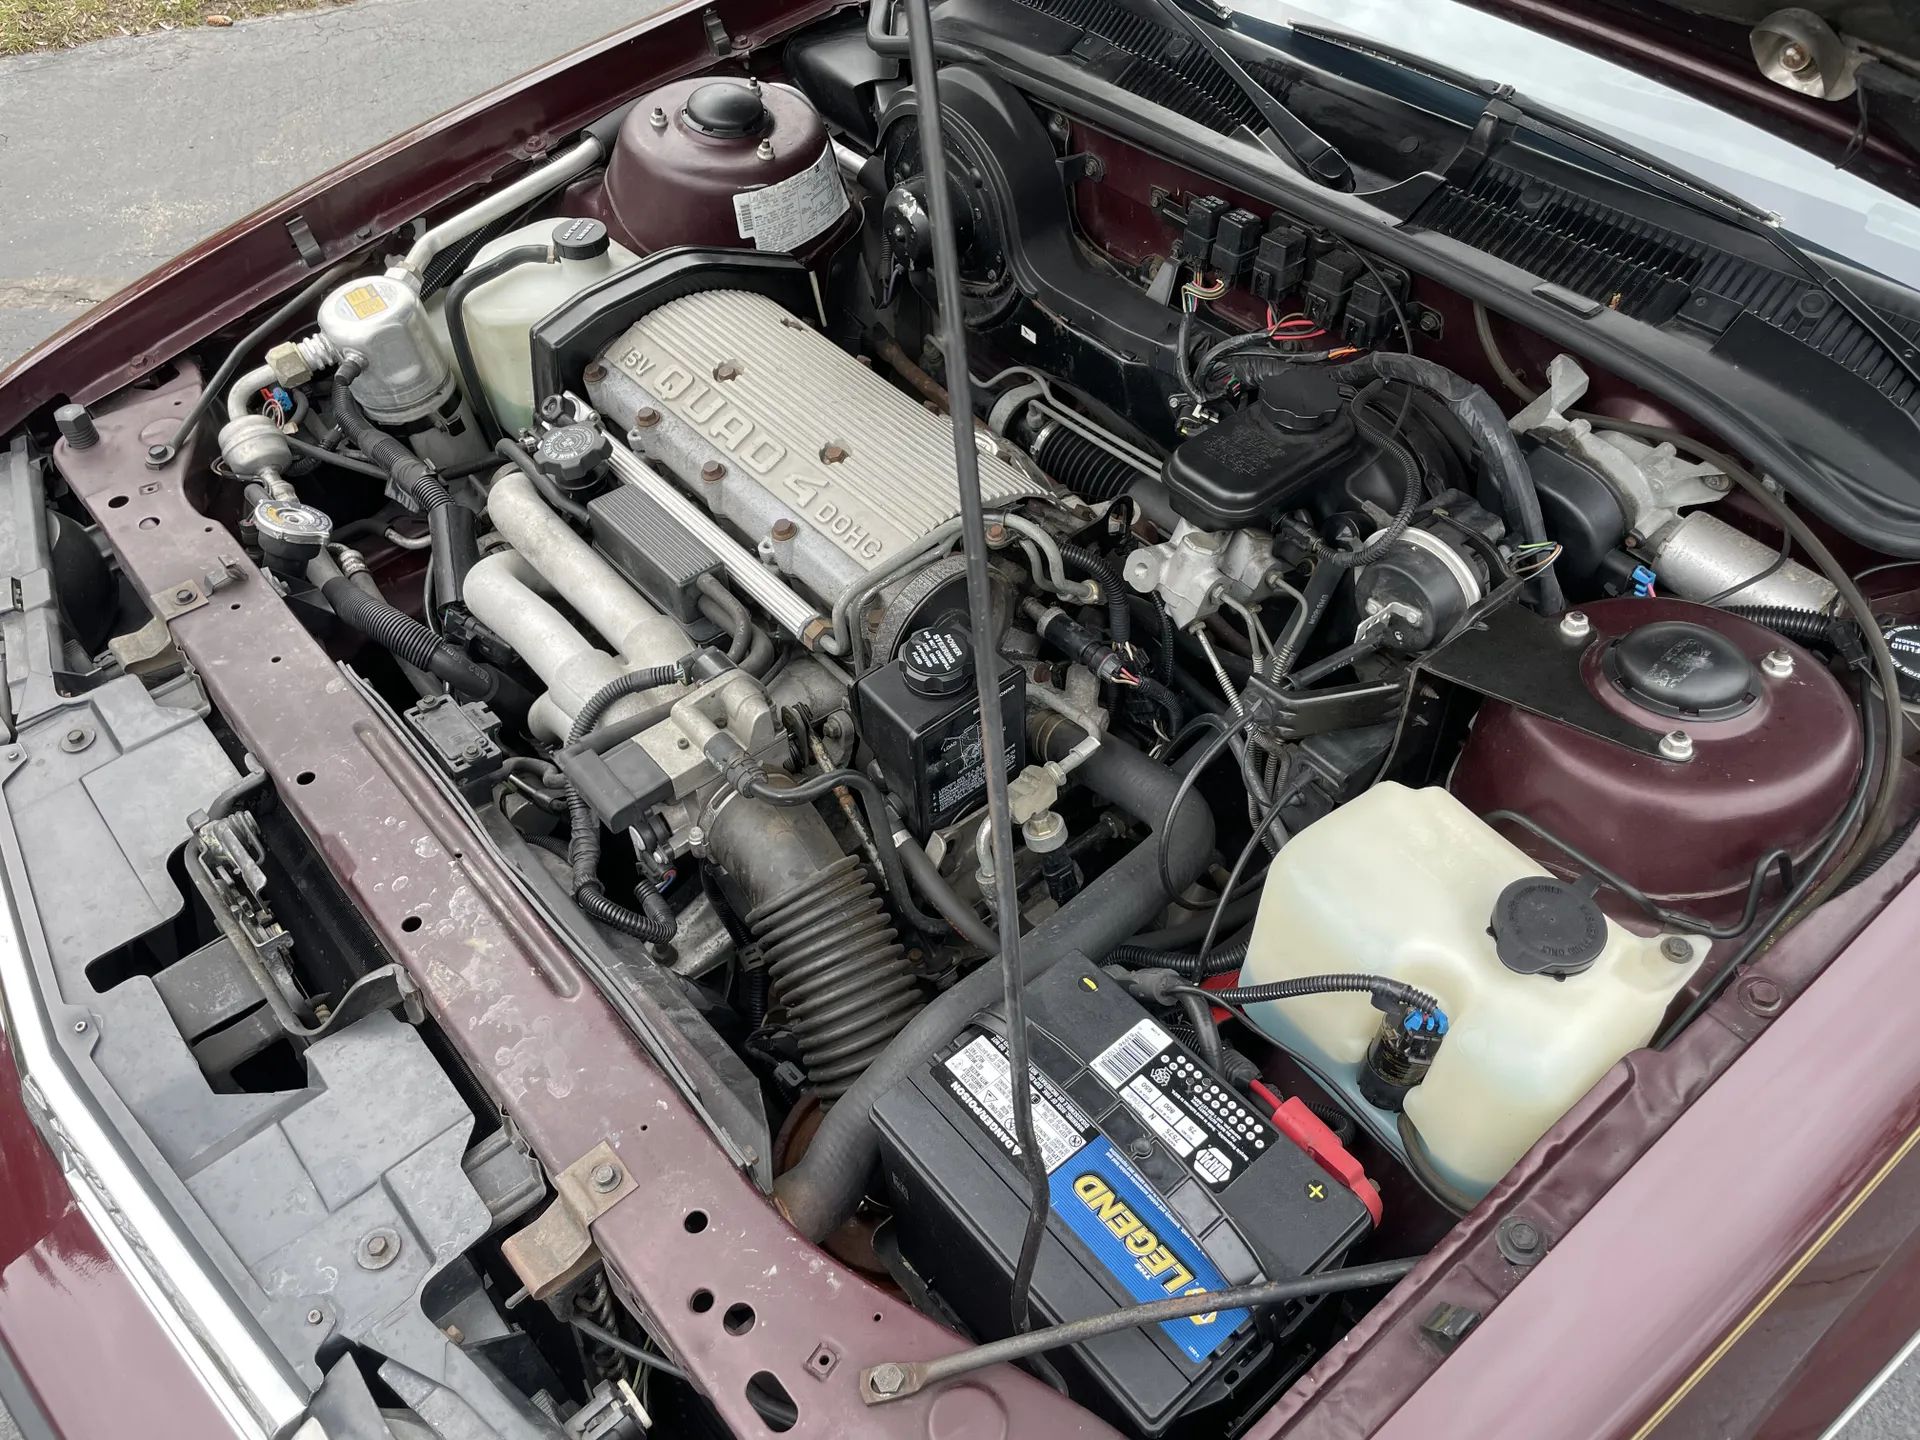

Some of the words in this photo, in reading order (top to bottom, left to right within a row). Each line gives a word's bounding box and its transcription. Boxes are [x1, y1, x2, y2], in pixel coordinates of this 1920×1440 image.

[653, 364, 787, 474] QUAD
[783, 471, 830, 508] 4
[814, 503, 883, 560] DOHC
[932, 632, 956, 664] STEERING
[942, 632, 963, 657] POWER
[1891, 642, 1920, 654] FLUID
[950, 1081, 1016, 1150] DANGER/POISON
[1147, 1111, 1157, 1121] N
[1197, 1149, 1228, 1179] NAPA
[1073, 1175, 1195, 1294] LEGEND
